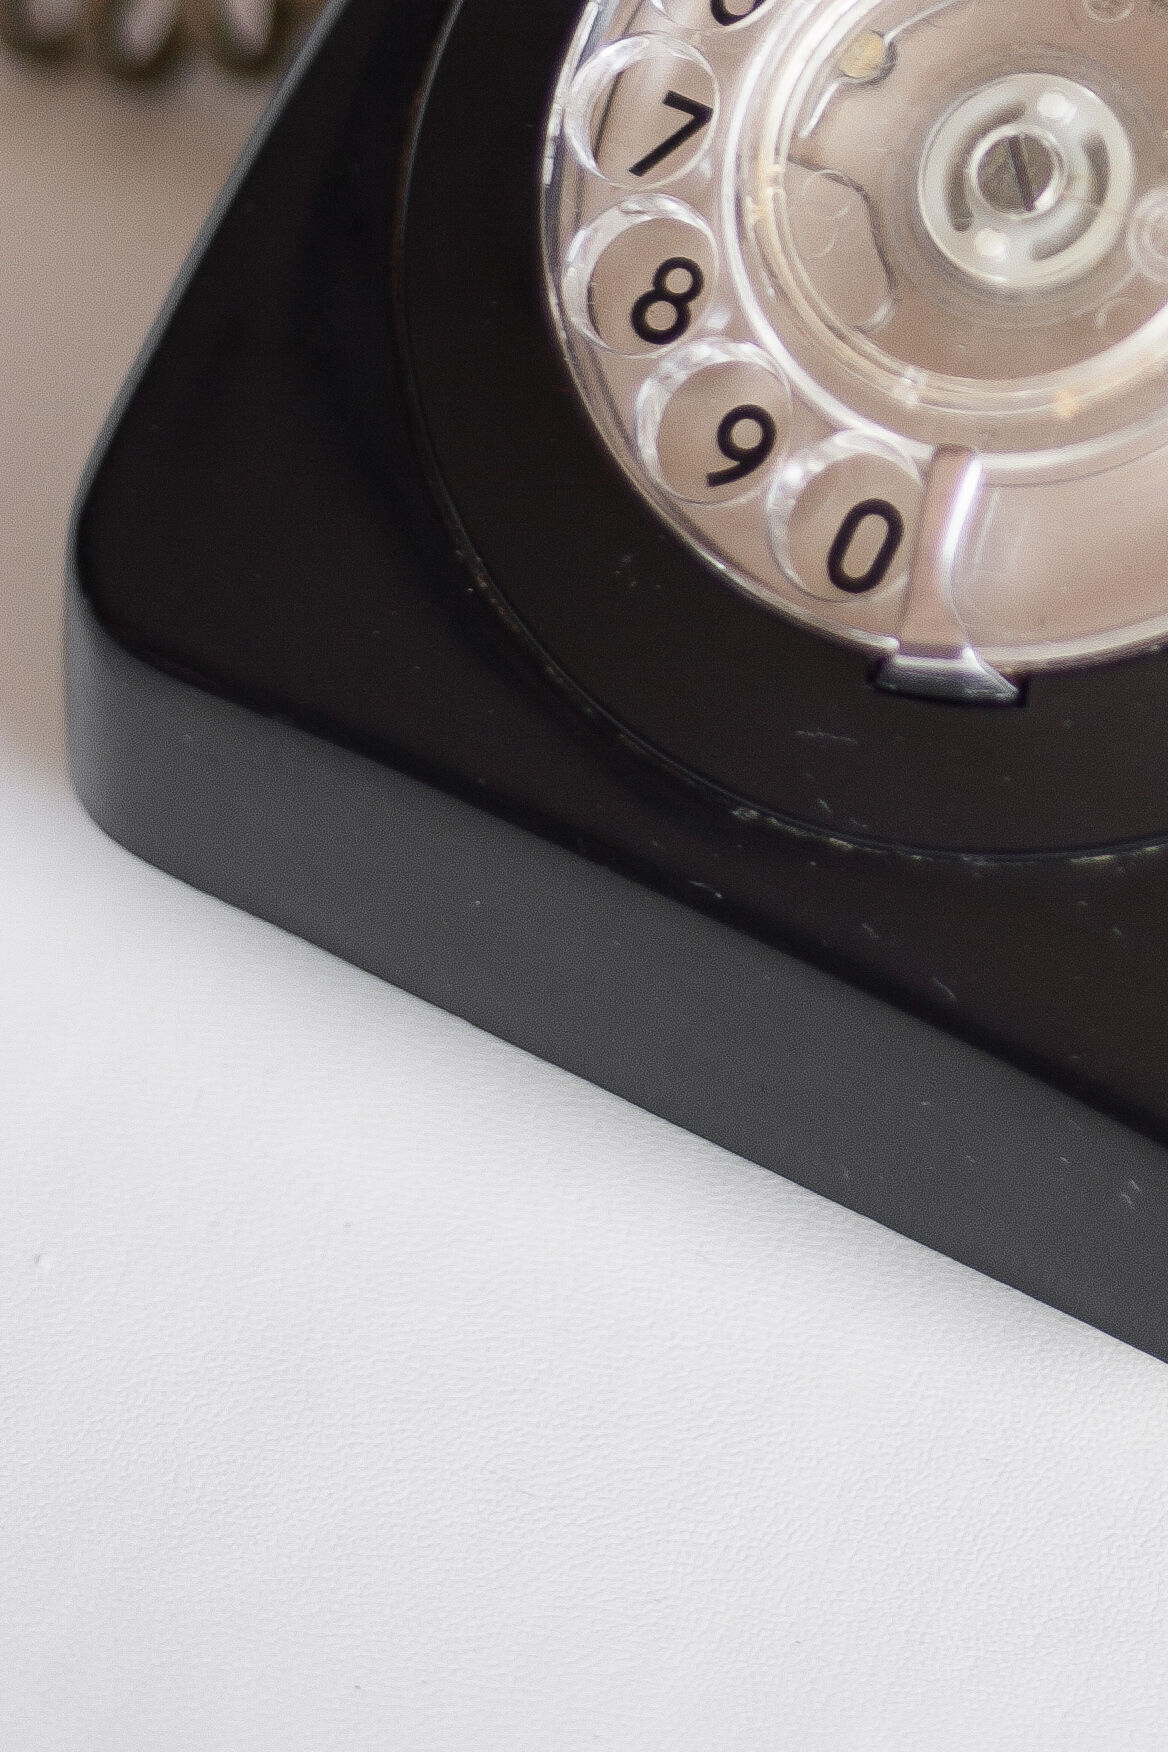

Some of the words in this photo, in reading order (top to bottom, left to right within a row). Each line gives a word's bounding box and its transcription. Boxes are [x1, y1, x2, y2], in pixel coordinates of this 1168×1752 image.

[628, 89, 713, 178] 7
[629, 255, 704, 346] 8
[705, 403, 778, 488] 9
[825, 498, 905, 595] 0
